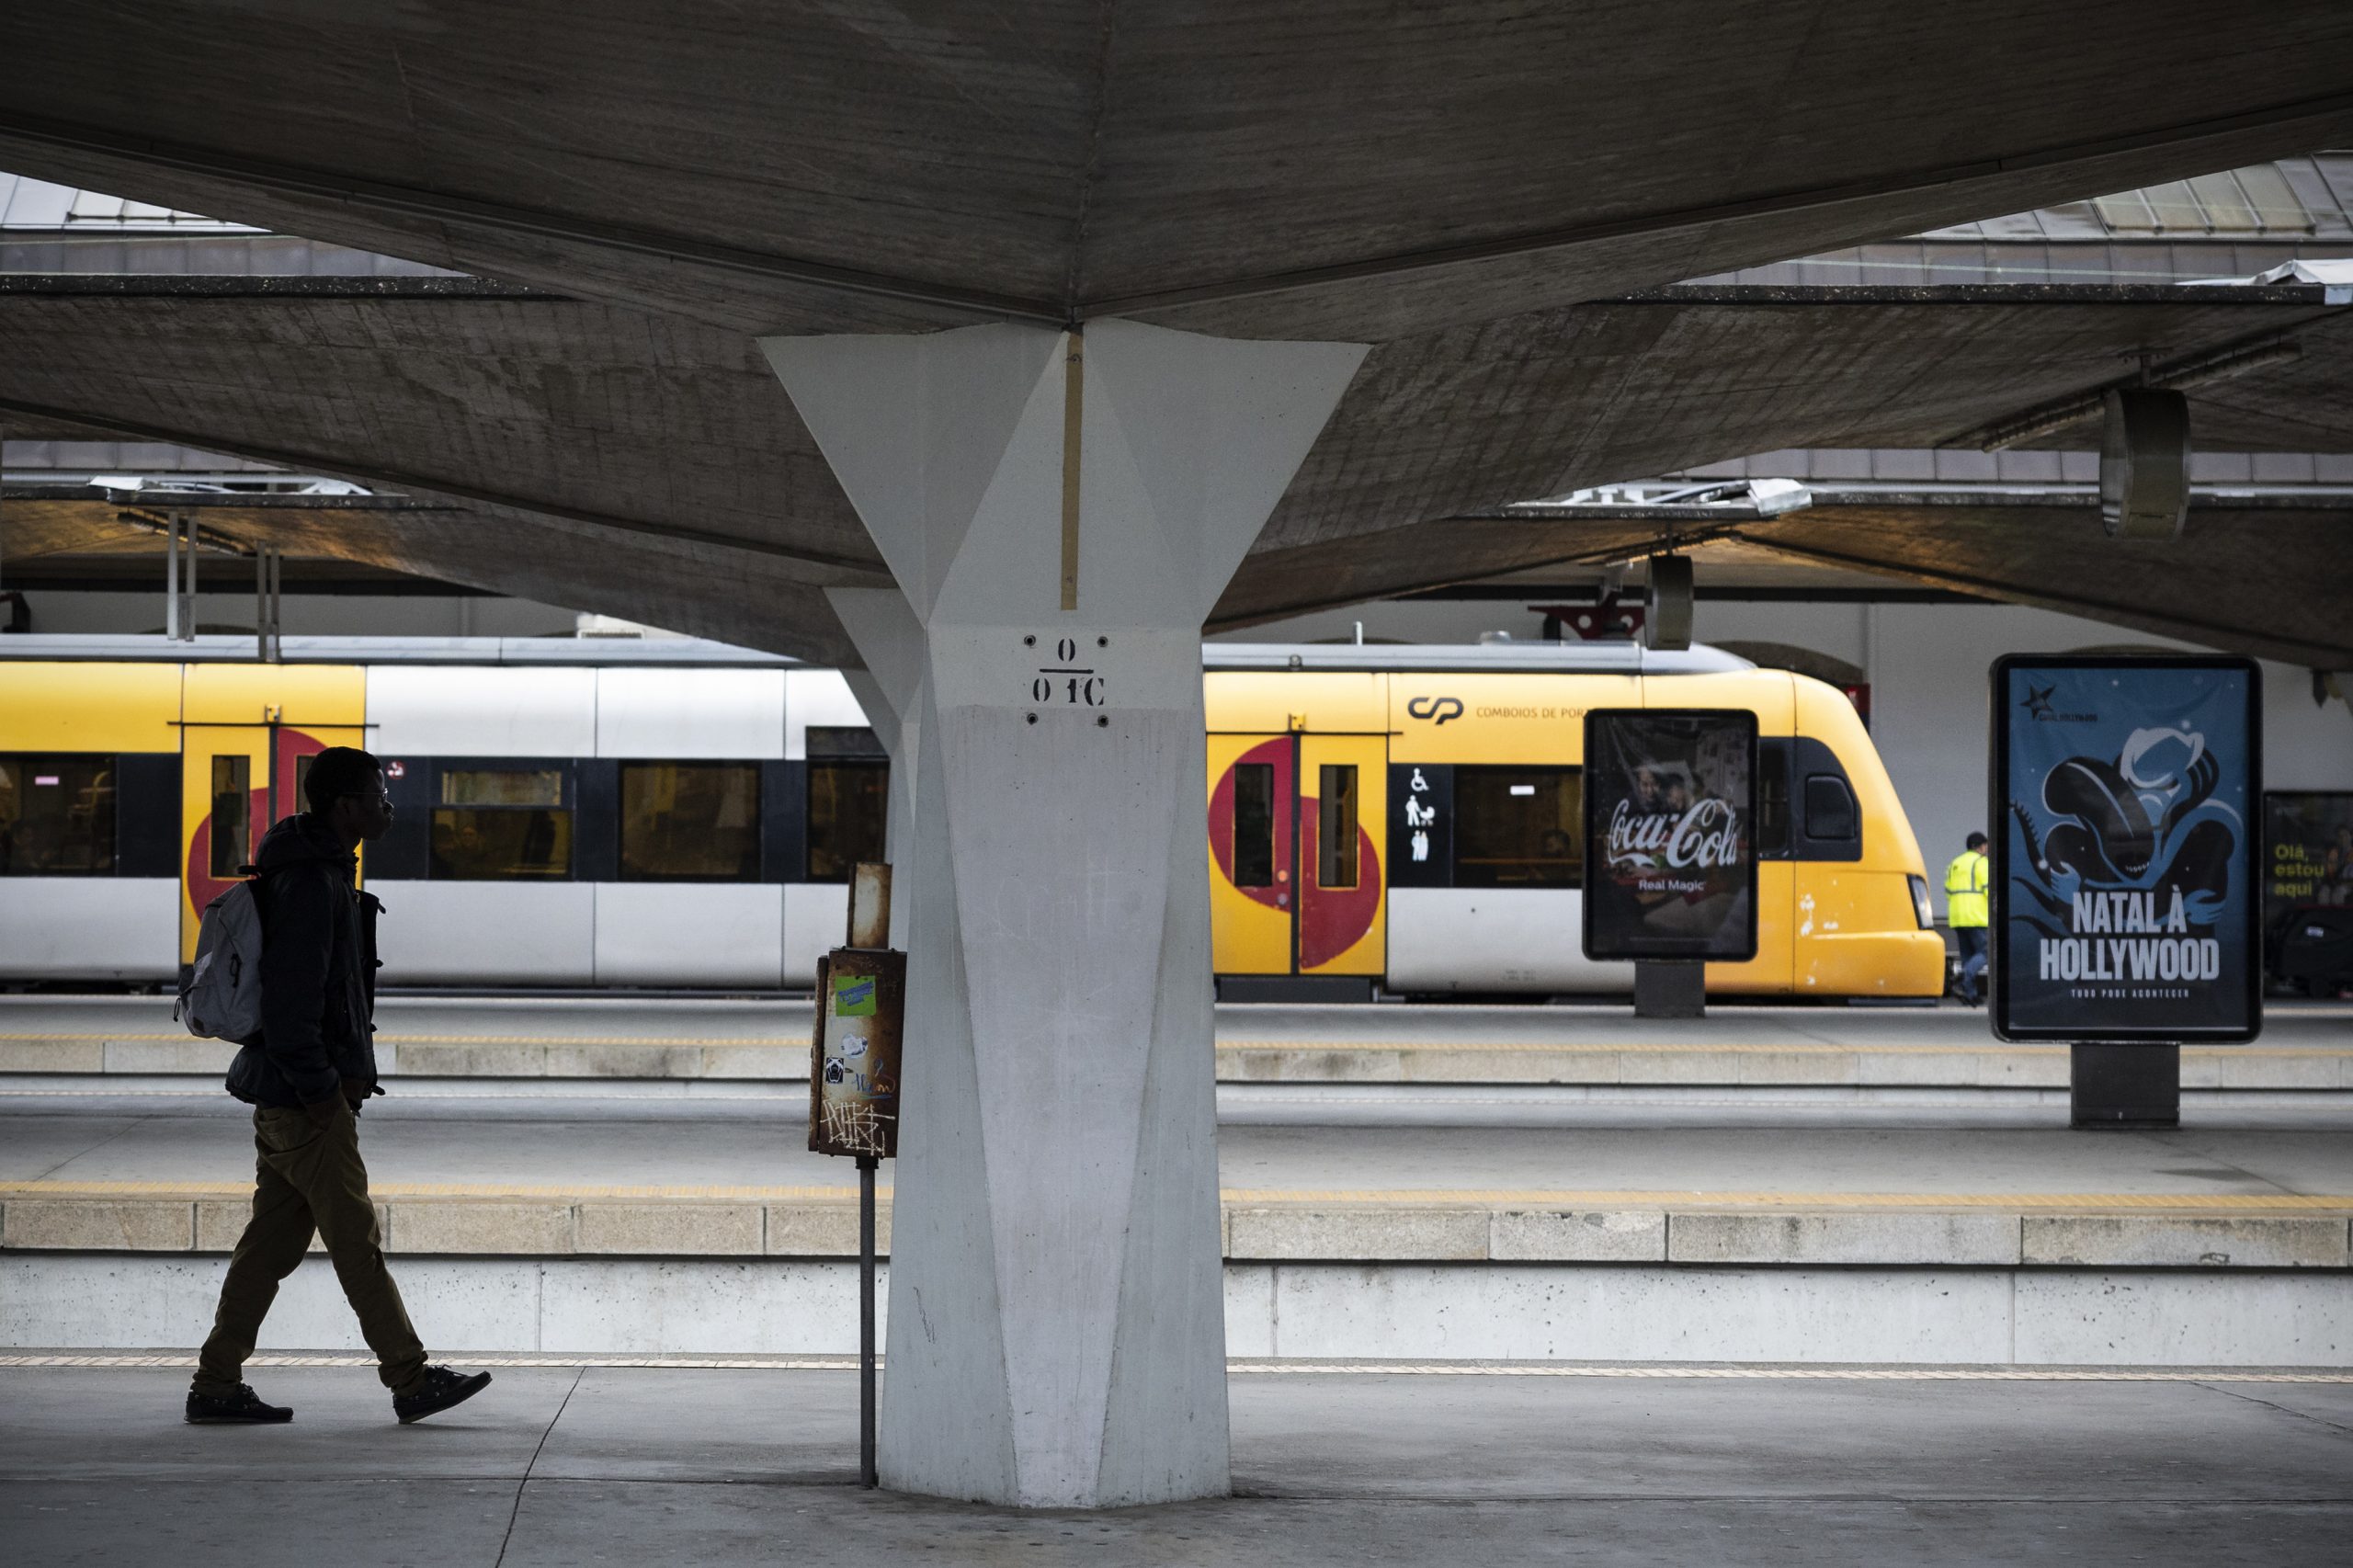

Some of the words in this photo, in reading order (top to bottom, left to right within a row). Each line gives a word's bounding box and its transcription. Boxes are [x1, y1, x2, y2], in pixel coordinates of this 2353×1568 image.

[1475, 706, 1538, 719] COMBOIOS
[1541, 707, 1557, 719] DE
[1561, 707, 1586, 719] POR
[1608, 798, 1737, 869] Coca-Cola
[2275, 843, 2309, 863] Olá,
[2274, 862, 2325, 877] estou
[1639, 879, 1665, 891] Real
[1668, 879, 1705, 892] Magic
[2274, 881, 2313, 898] aqui
[2073, 891, 2162, 934] NATAL
[2167, 884, 2188, 934] À
[2040, 938, 2220, 982] HOLLYWOOD
[2070, 989, 2096, 999] TUDO
[2101, 989, 2126, 999] PODE
[2131, 989, 2189, 999] ACONTECER
